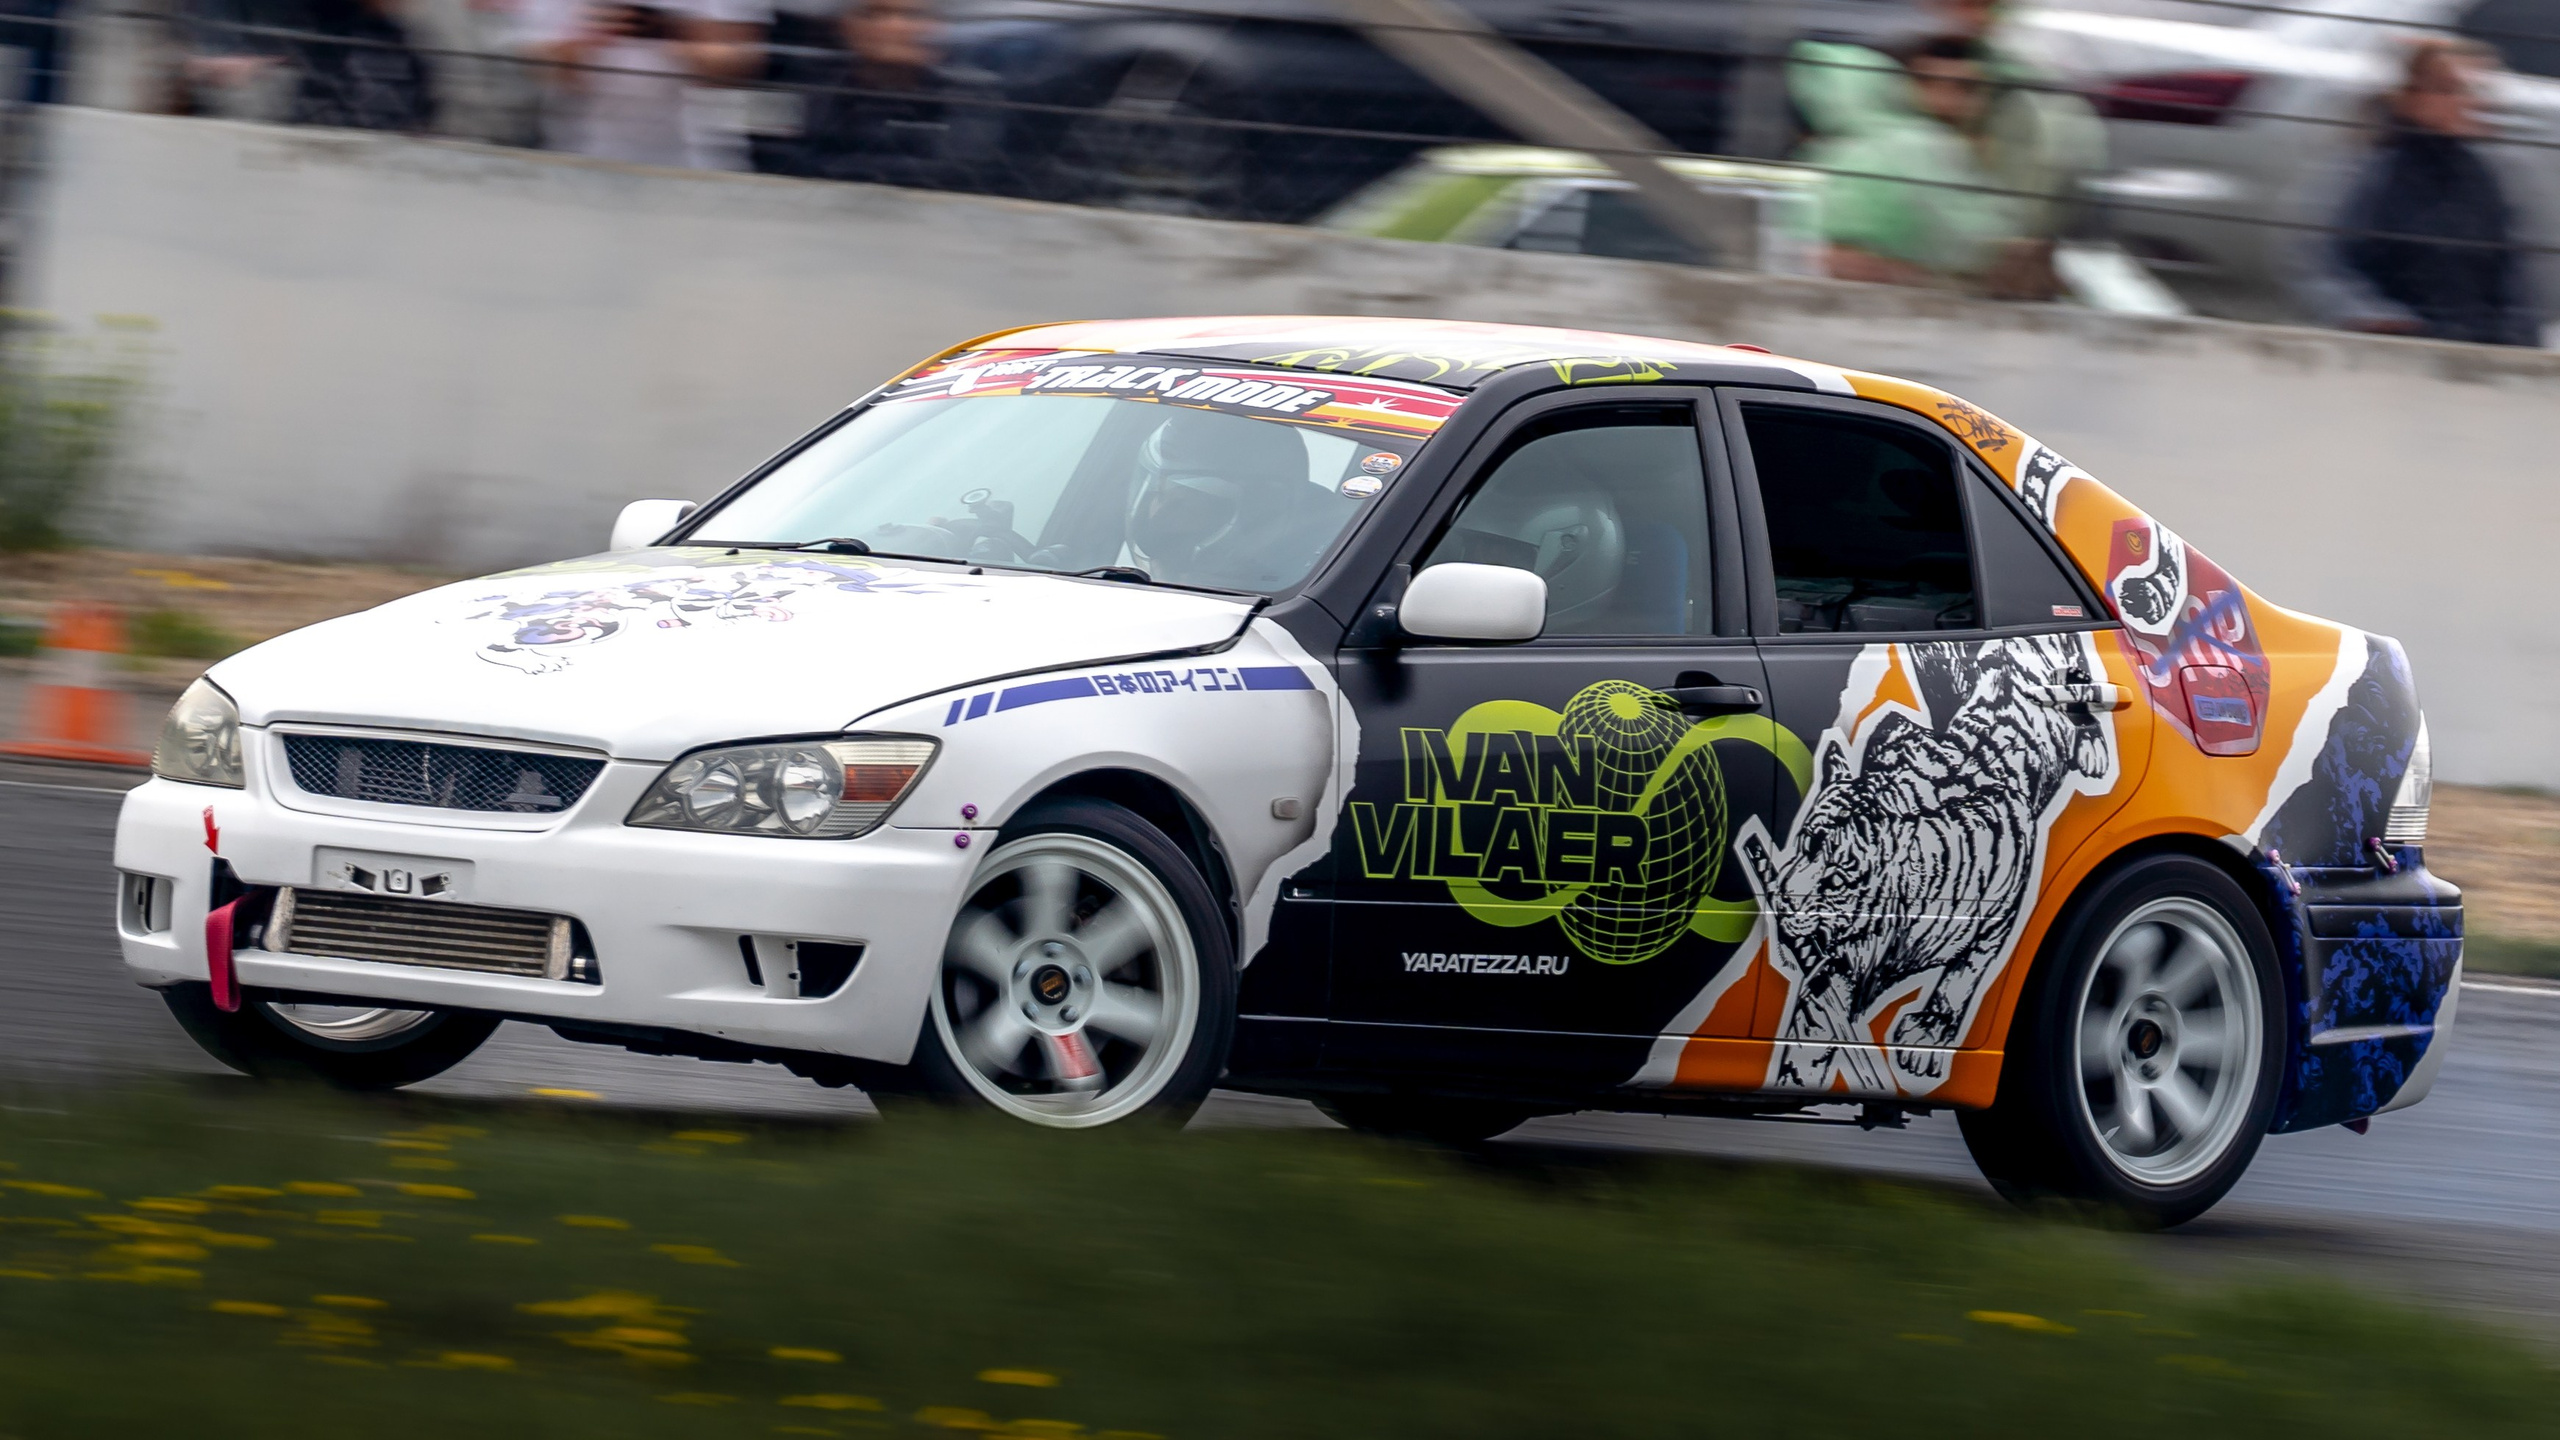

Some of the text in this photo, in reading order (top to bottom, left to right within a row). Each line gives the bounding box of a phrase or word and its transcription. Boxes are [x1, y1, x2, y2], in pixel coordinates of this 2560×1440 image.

[1091, 668, 1243, 695] 日本のアイコン
[1400, 727, 1600, 809] IVAN
[1350, 801, 1649, 887] VILAER
[1402, 952, 1570, 975] YARATEZZA.RU
